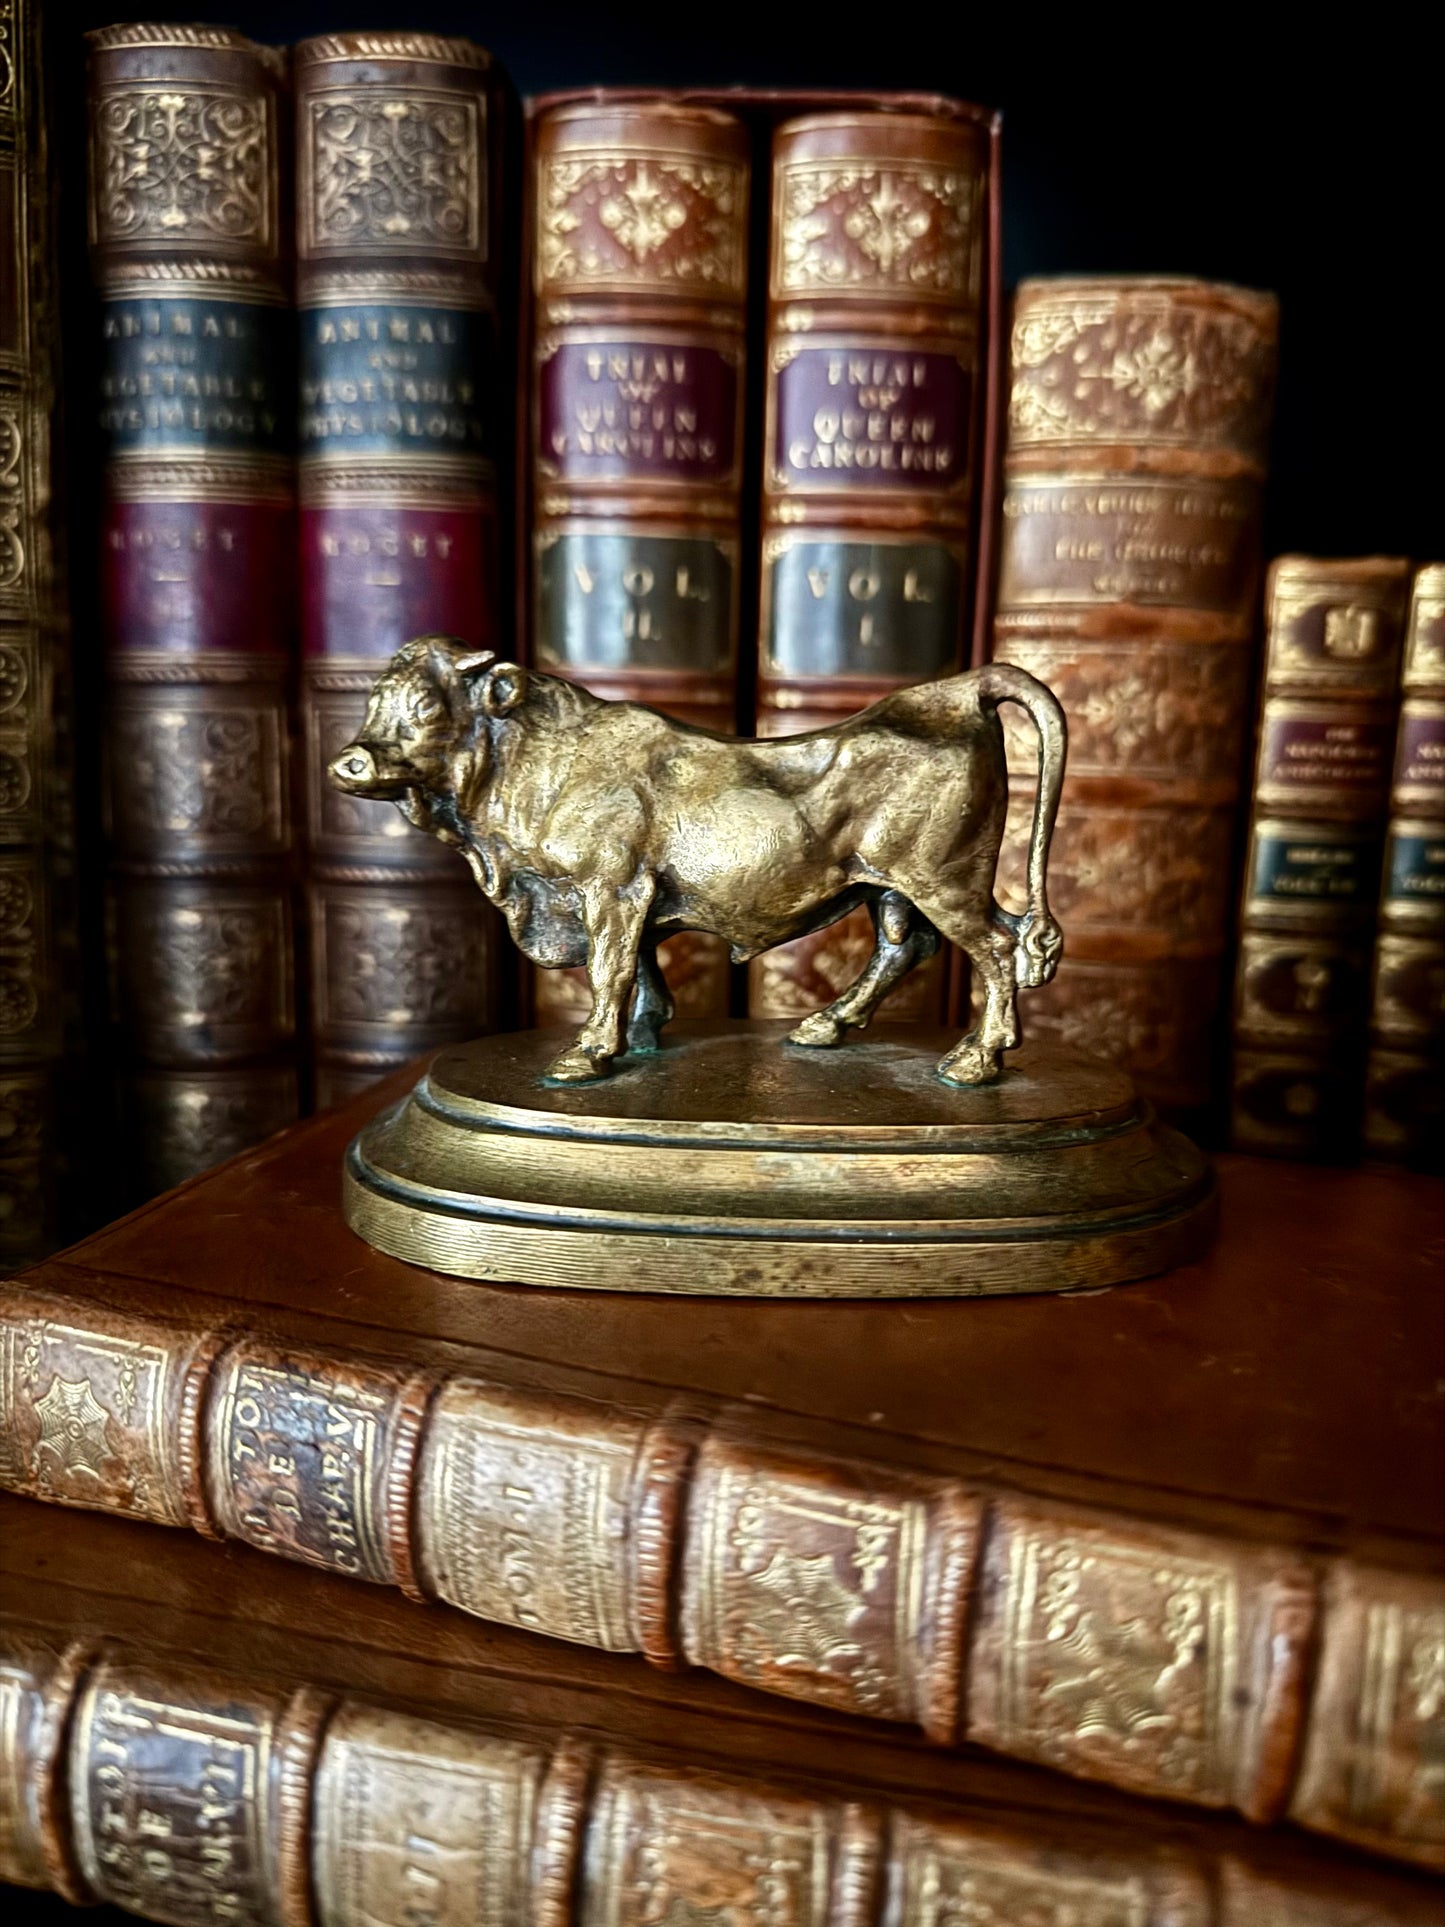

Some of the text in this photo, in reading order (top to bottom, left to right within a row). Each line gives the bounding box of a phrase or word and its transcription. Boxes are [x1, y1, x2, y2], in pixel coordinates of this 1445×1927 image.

[104, 312, 246, 337] ANIMAL
[318, 316, 456, 344] ANIMAL
[104, 373, 263, 400] EGETABLE
[857, 385, 900, 411] OF
[101, 404, 277, 433] HYSIOLOGY
[812, 410, 936, 444] QUEEN
[788, 441, 951, 472] CAROLINE
[269, 1452, 302, 1522] DE
